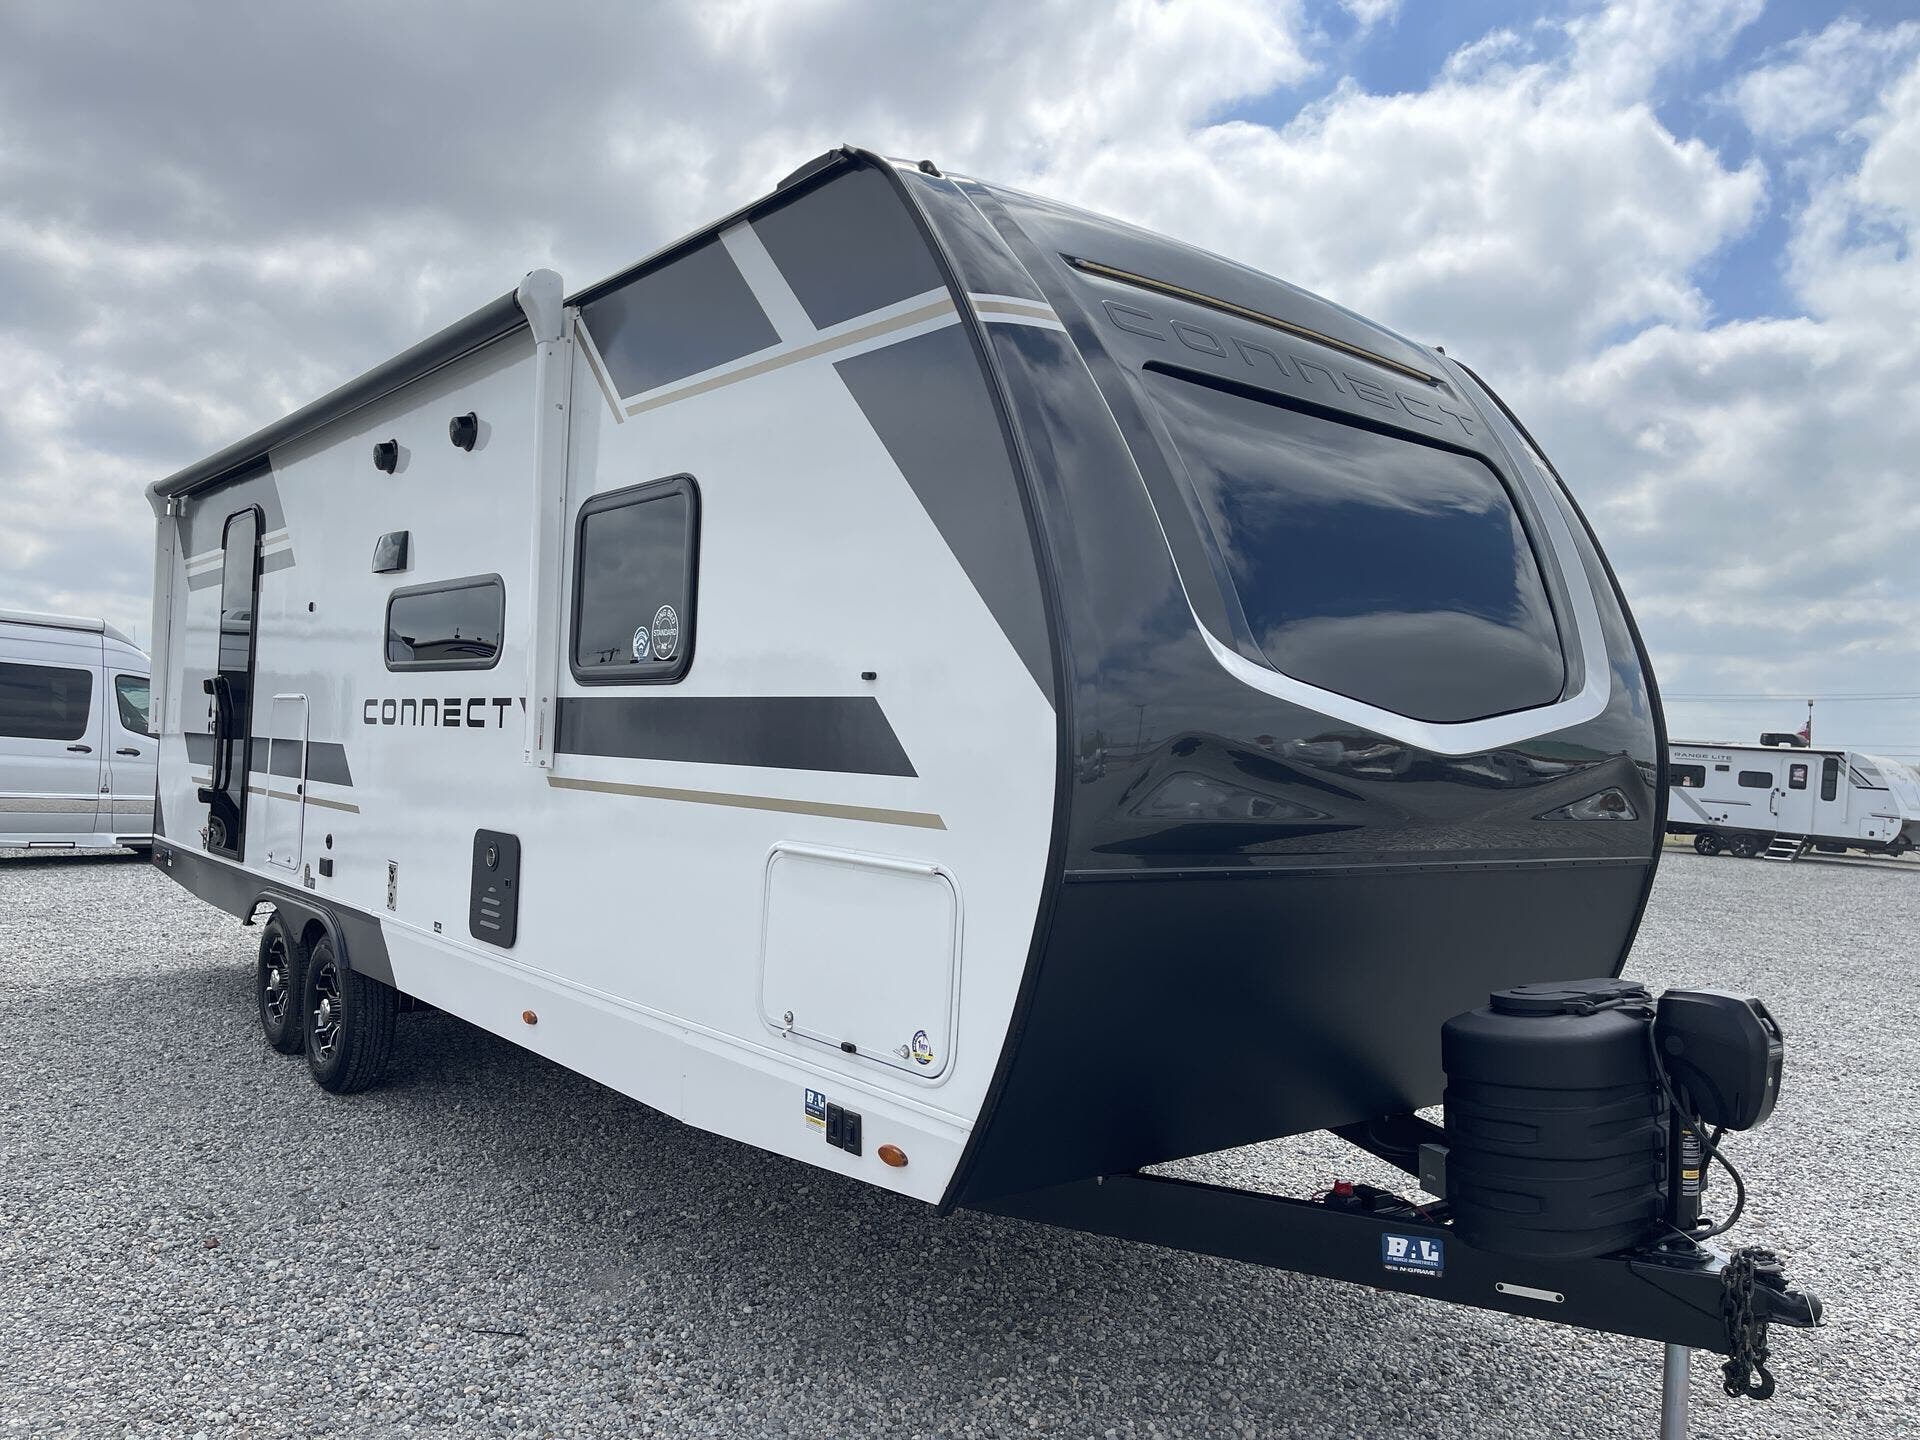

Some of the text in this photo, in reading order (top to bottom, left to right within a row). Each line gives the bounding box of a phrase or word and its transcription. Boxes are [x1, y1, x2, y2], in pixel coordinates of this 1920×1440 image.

[1102, 298, 1474, 437] CONNECT
[656, 608, 676, 626] KING BED
[653, 628, 677, 637] STANDARD
[363, 697, 512, 729] CONNECT
[1387, 1236, 1439, 1261] BAL
